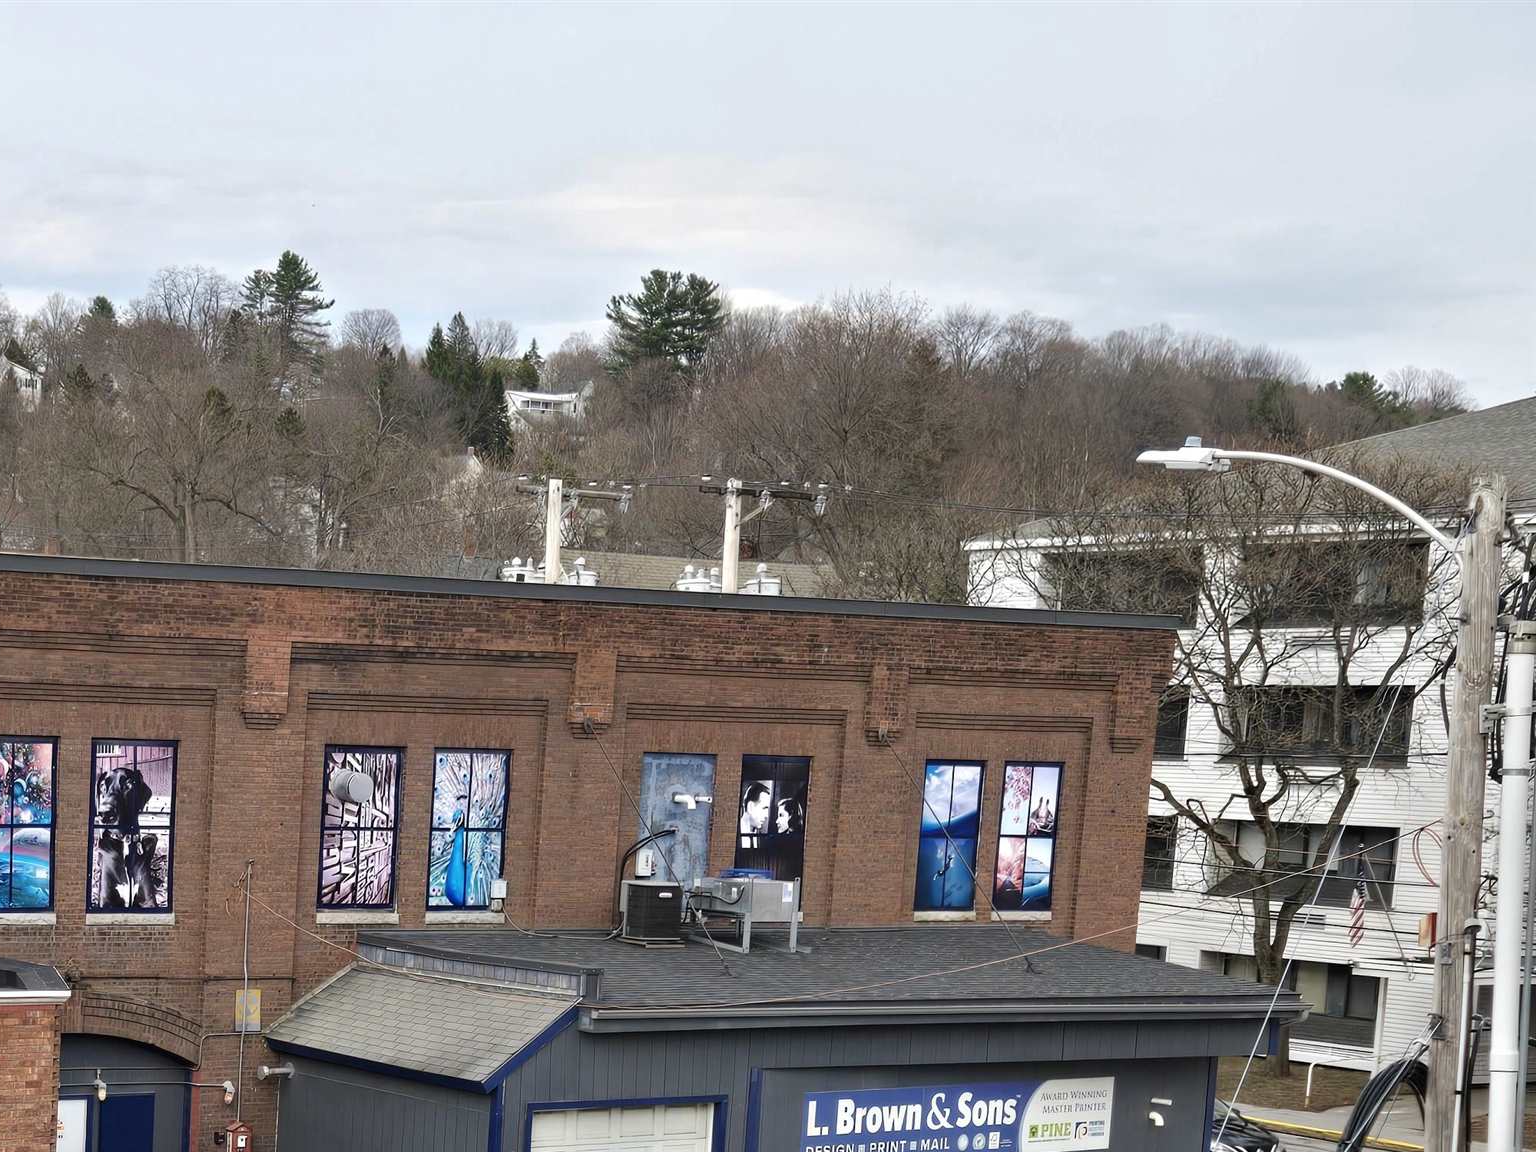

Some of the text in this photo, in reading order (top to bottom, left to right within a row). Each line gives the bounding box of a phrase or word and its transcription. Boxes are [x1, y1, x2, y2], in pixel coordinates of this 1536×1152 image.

[1040, 1089, 1107, 1102] AWARD WINNING
[807, 1091, 1017, 1136] L. Brown & Sons
[1042, 1103, 1106, 1114] MASTER PRINTER
[1040, 1122, 1072, 1138] PINE
[920, 1137, 950, 1151] MAIL
